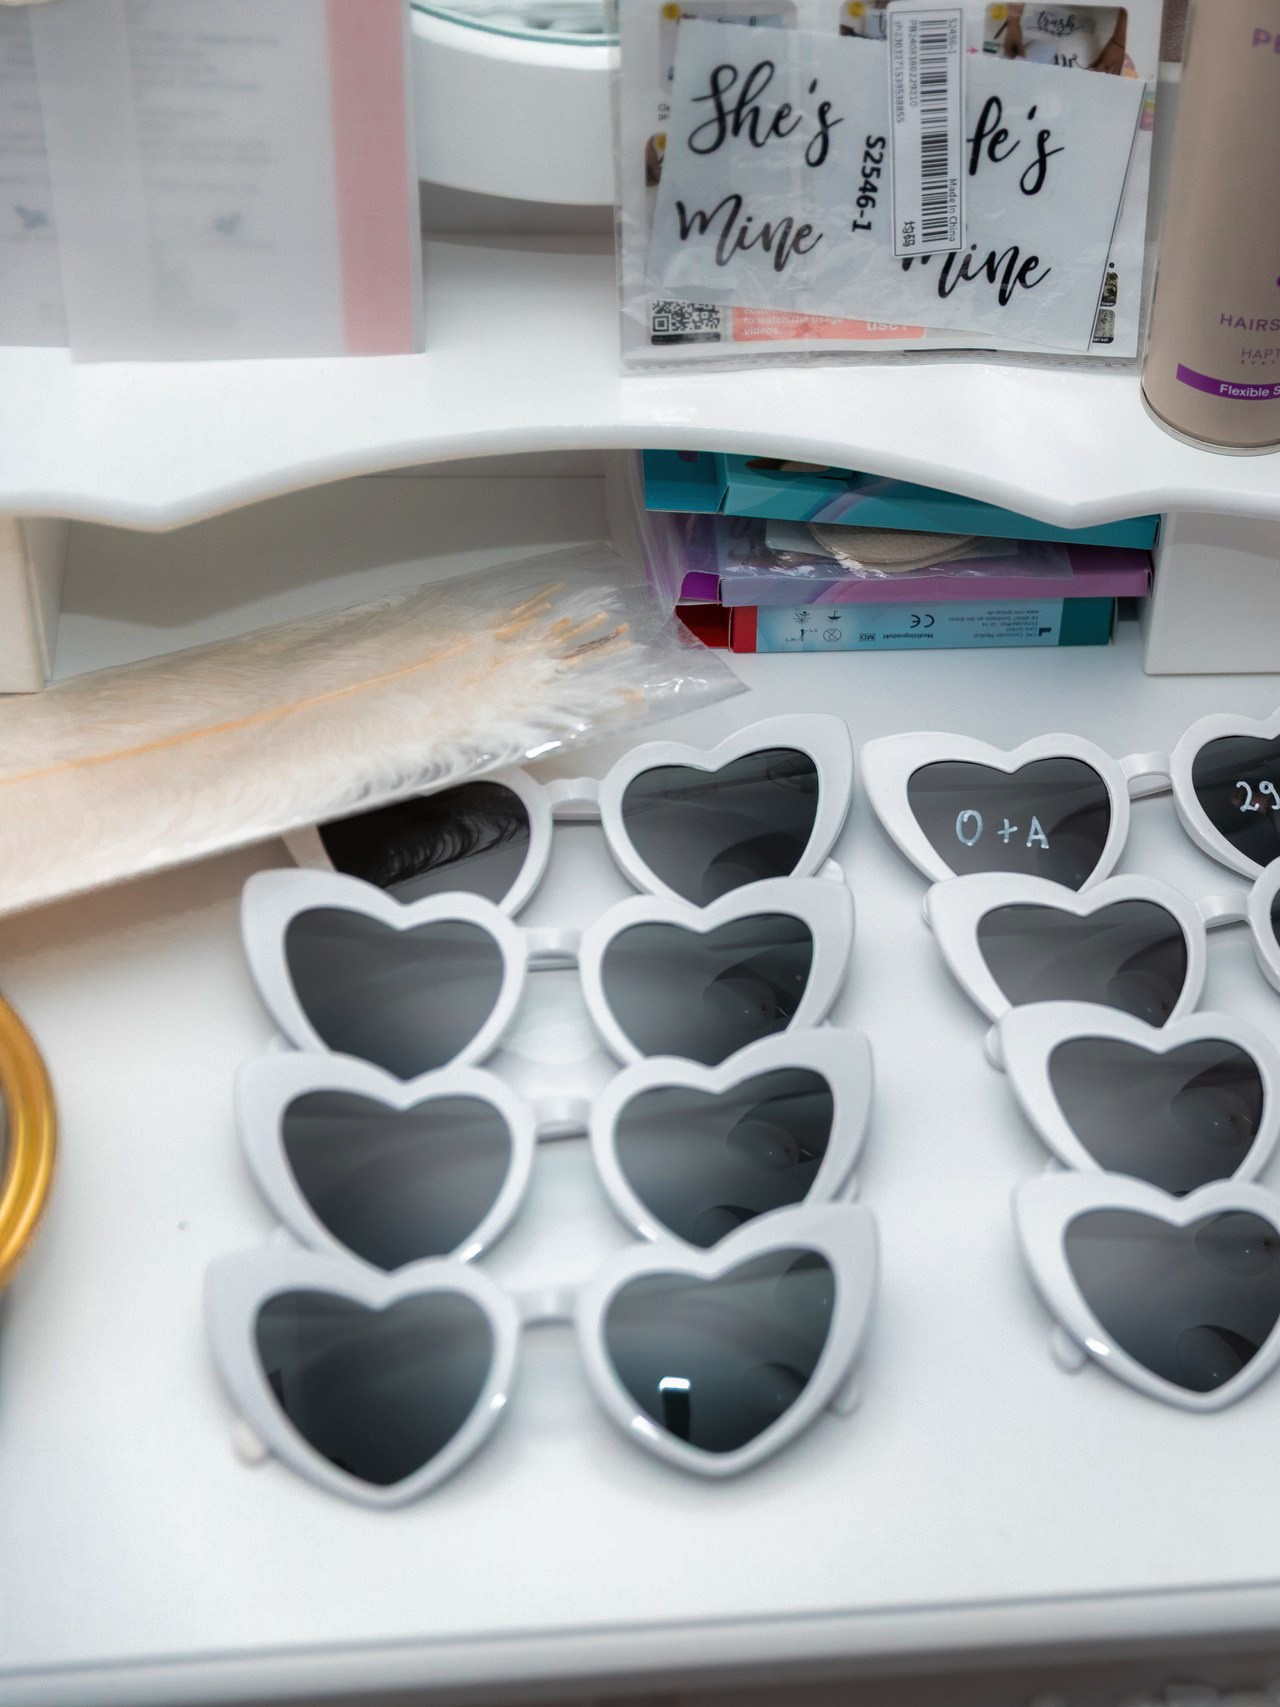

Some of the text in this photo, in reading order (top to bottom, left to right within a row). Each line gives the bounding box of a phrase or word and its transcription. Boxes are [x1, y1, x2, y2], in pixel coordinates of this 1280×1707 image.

[688, 60, 845, 168] She's
[852, 134, 886, 233] S2546-1
[948, 178, 958, 242] Made In China
[902, 220, 916, 247] 均码
[744, 316, 755, 325] to
[758, 315, 789, 325] watch
[1219, 383, 1270, 398] Flexible
[882, 632, 934, 640] Medizinprodukt
[997, 818, 1018, 844] +
[1026, 815, 1049, 849] A
